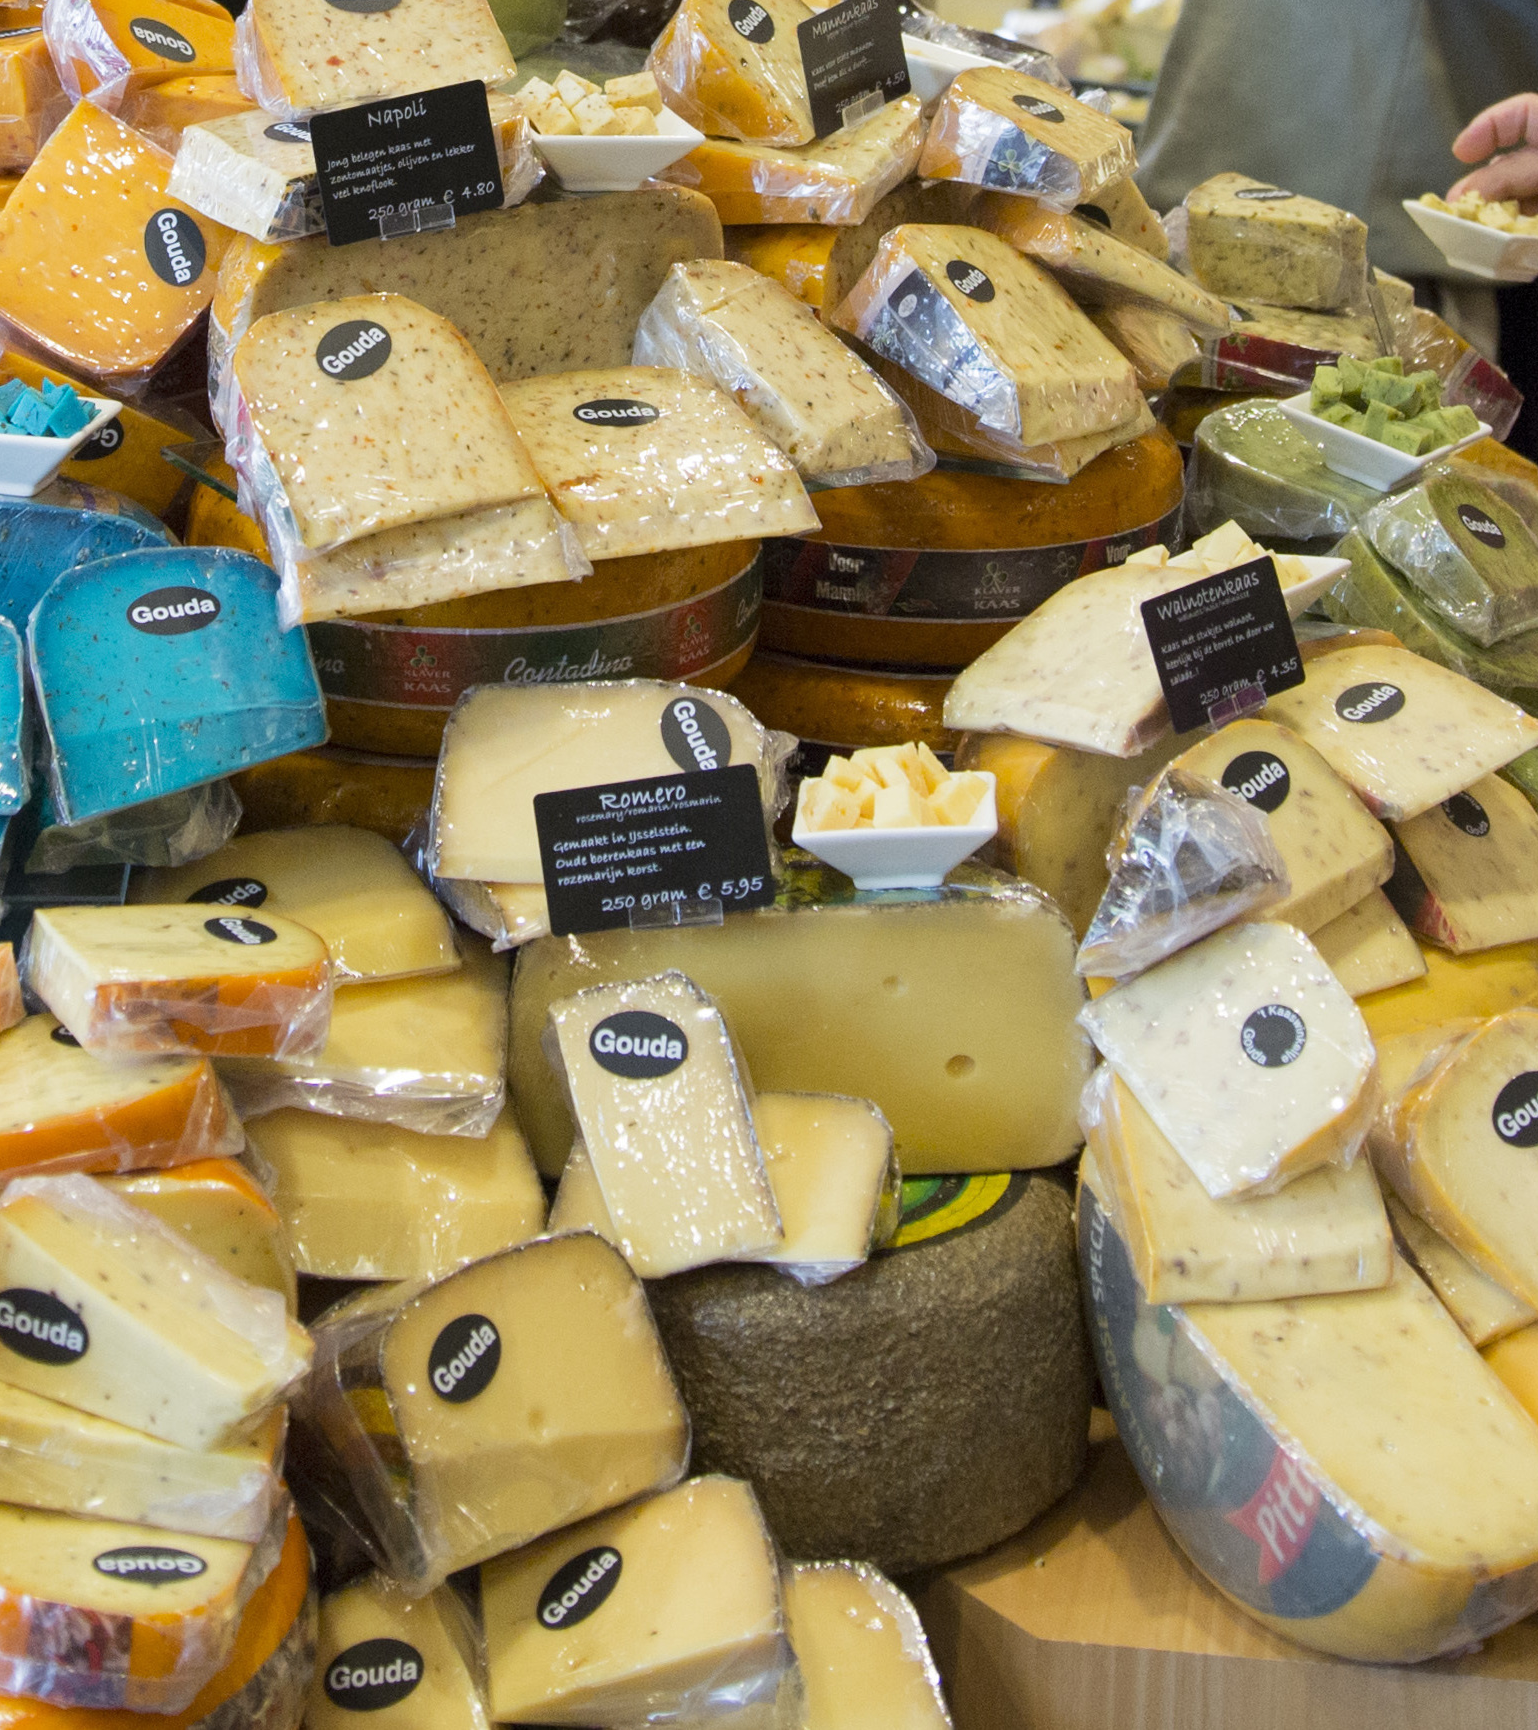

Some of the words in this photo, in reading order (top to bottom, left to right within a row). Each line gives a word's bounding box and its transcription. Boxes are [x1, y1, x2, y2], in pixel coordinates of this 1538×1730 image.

[734, 5, 768, 36] Gouda
[134, 26, 193, 55] Gouda
[886, 70, 906, 88] 4.50
[368, 98, 427, 129] Napoli
[330, 162, 395, 185] zontomaatjes,
[397, 154, 429, 170] olijven
[431, 151, 443, 162] en
[445, 143, 475, 157] lekker
[351, 148, 386, 165] belegen
[388, 141, 411, 154] kaas
[414, 137, 432, 148] met
[332, 188, 351, 200] veel
[353, 178, 398, 195] knoflook.
[368, 204, 394, 221] 250
[398, 195, 435, 216] gram
[443, 190, 455, 204] €
[461, 181, 494, 200] 4.80
[157, 213, 192, 284] Gouda
[954, 268, 987, 295] Gouda
[321, 327, 386, 374] Gouda
[576, 405, 656, 420] Gouda
[1462, 510, 1503, 536] Gouda
[974, 584, 1022, 596] KLAVER
[974, 598, 1022, 610] KAAS
[1156, 571, 1260, 621] Walnotenkaas
[132, 597, 216, 626] Gouda
[1165, 650, 1193, 670] heerlijk
[1193, 646, 1204, 662] bij
[1204, 644, 1213, 655] de
[1213, 635, 1234, 652] borrel
[1235, 632, 1245, 643] en
[1246, 626, 1261, 638] door
[1181, 635, 1196, 646] met
[1196, 623, 1223, 643] stukjes
[403, 667, 450, 679] KLAVER
[504, 650, 633, 685] Contadino
[1199, 690, 1219, 706] 250
[1222, 677, 1251, 698] gram
[1256, 668, 1267, 685] €
[1270, 657, 1297, 678] 4.35
[403, 681, 451, 694] KAAS
[1343, 685, 1399, 721] Gouda
[672, 700, 719, 771] Gouda
[575, 795, 722, 824] rosemary/romarin/rosmarin
[598, 785, 686, 810] Romero
[553, 836, 609, 853] Gemaakt
[612, 832, 626, 843] in
[555, 855, 587, 869] Oude
[590, 846, 657, 865] boerenkaas
[660, 842, 683, 854] met
[685, 839, 706, 851] een
[557, 866, 624, 887] rozemarijn
[626, 862, 662, 877] korst.
[601, 896, 635, 912] 250
[640, 889, 687, 911] gram
[697, 883, 712, 901] €
[720, 875, 764, 899] 5.95
[594, 1029, 683, 1060] Gouda
[1242, 1028, 1268, 1066] Gouda
[1268, 1005, 1306, 1064] Kaaswinkeltje
[433, 1325, 496, 1393] Gouda
[97, 1557, 202, 1575] Gouda
[543, 1552, 618, 1625] Gouda
[330, 1660, 418, 1689] Gouda
